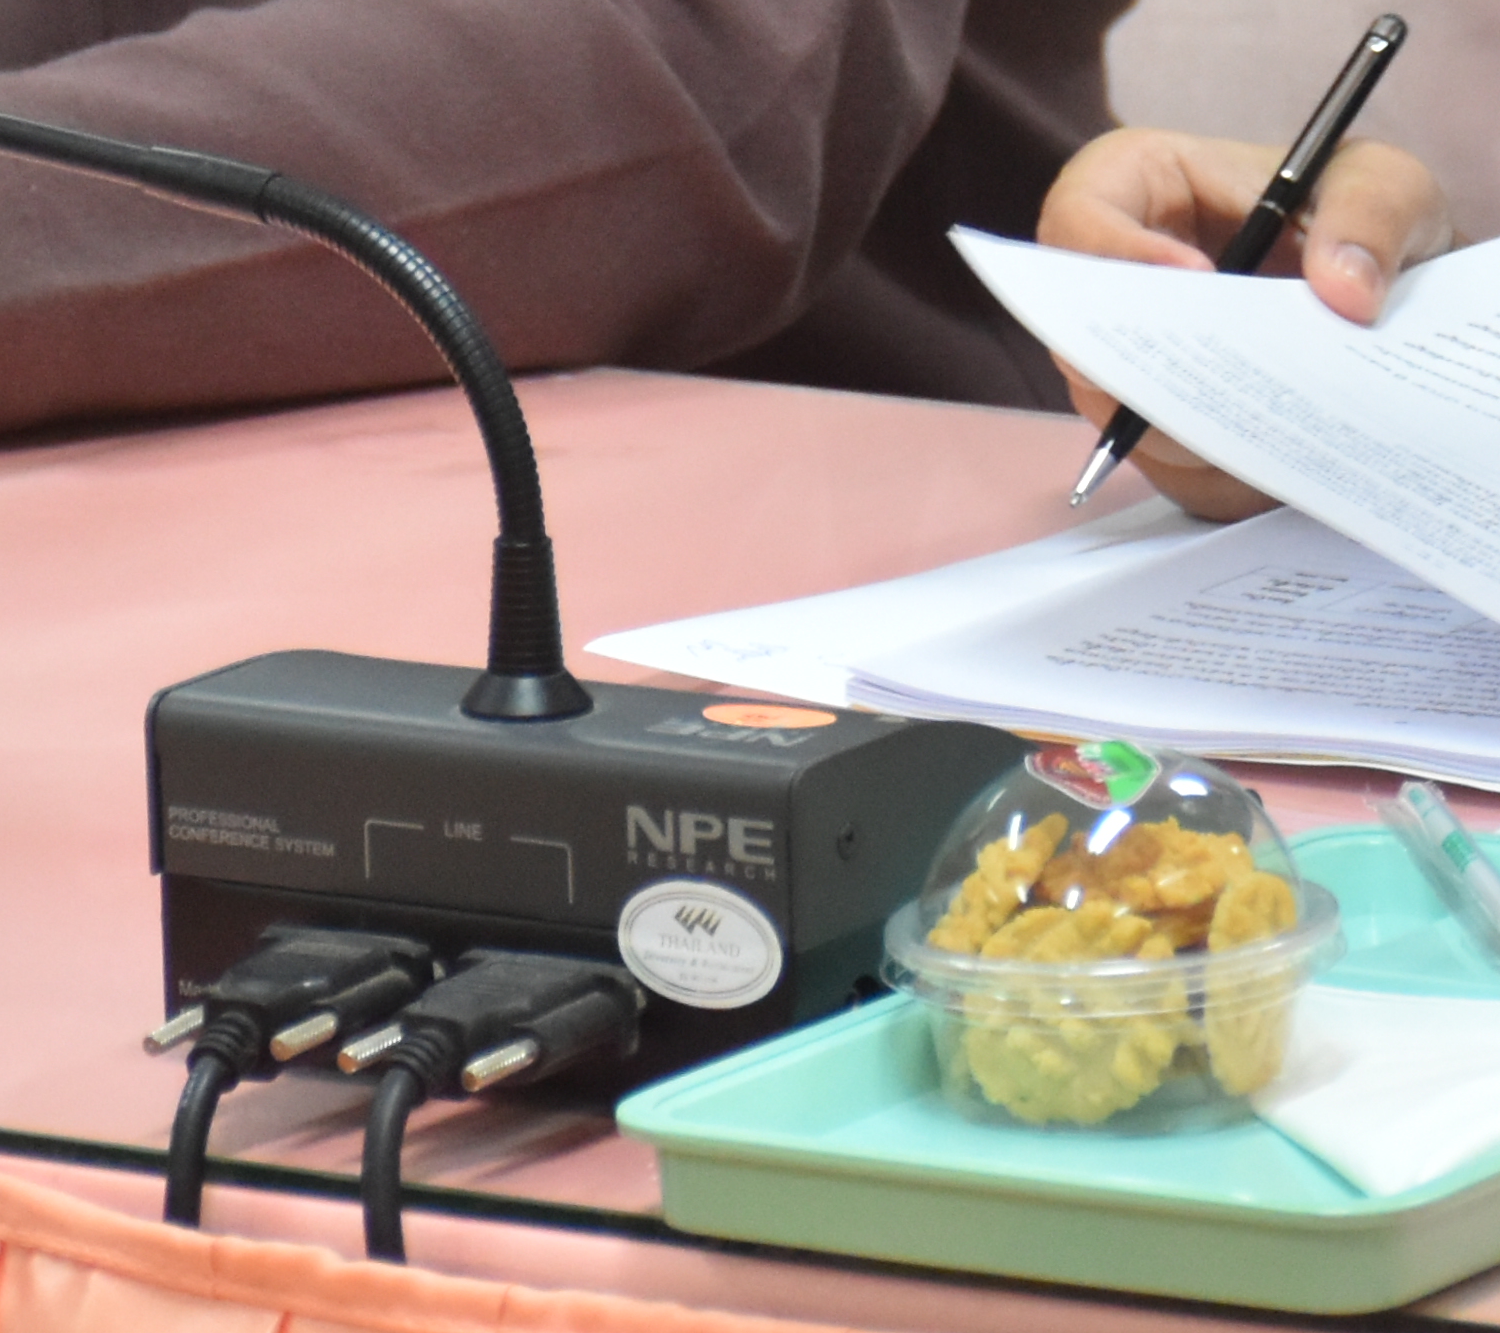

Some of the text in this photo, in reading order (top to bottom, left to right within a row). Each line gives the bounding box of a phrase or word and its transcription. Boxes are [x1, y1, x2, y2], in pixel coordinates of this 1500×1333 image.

[168, 805, 281, 834] PROFESSIONAL
[443, 819, 484, 842] LINE
[168, 824, 335, 857] CONFERENCE SYSTEM
[625, 804, 775, 866] NPE
[626, 850, 777, 882] RESEARCH
[658, 935, 742, 959] THAILAND
